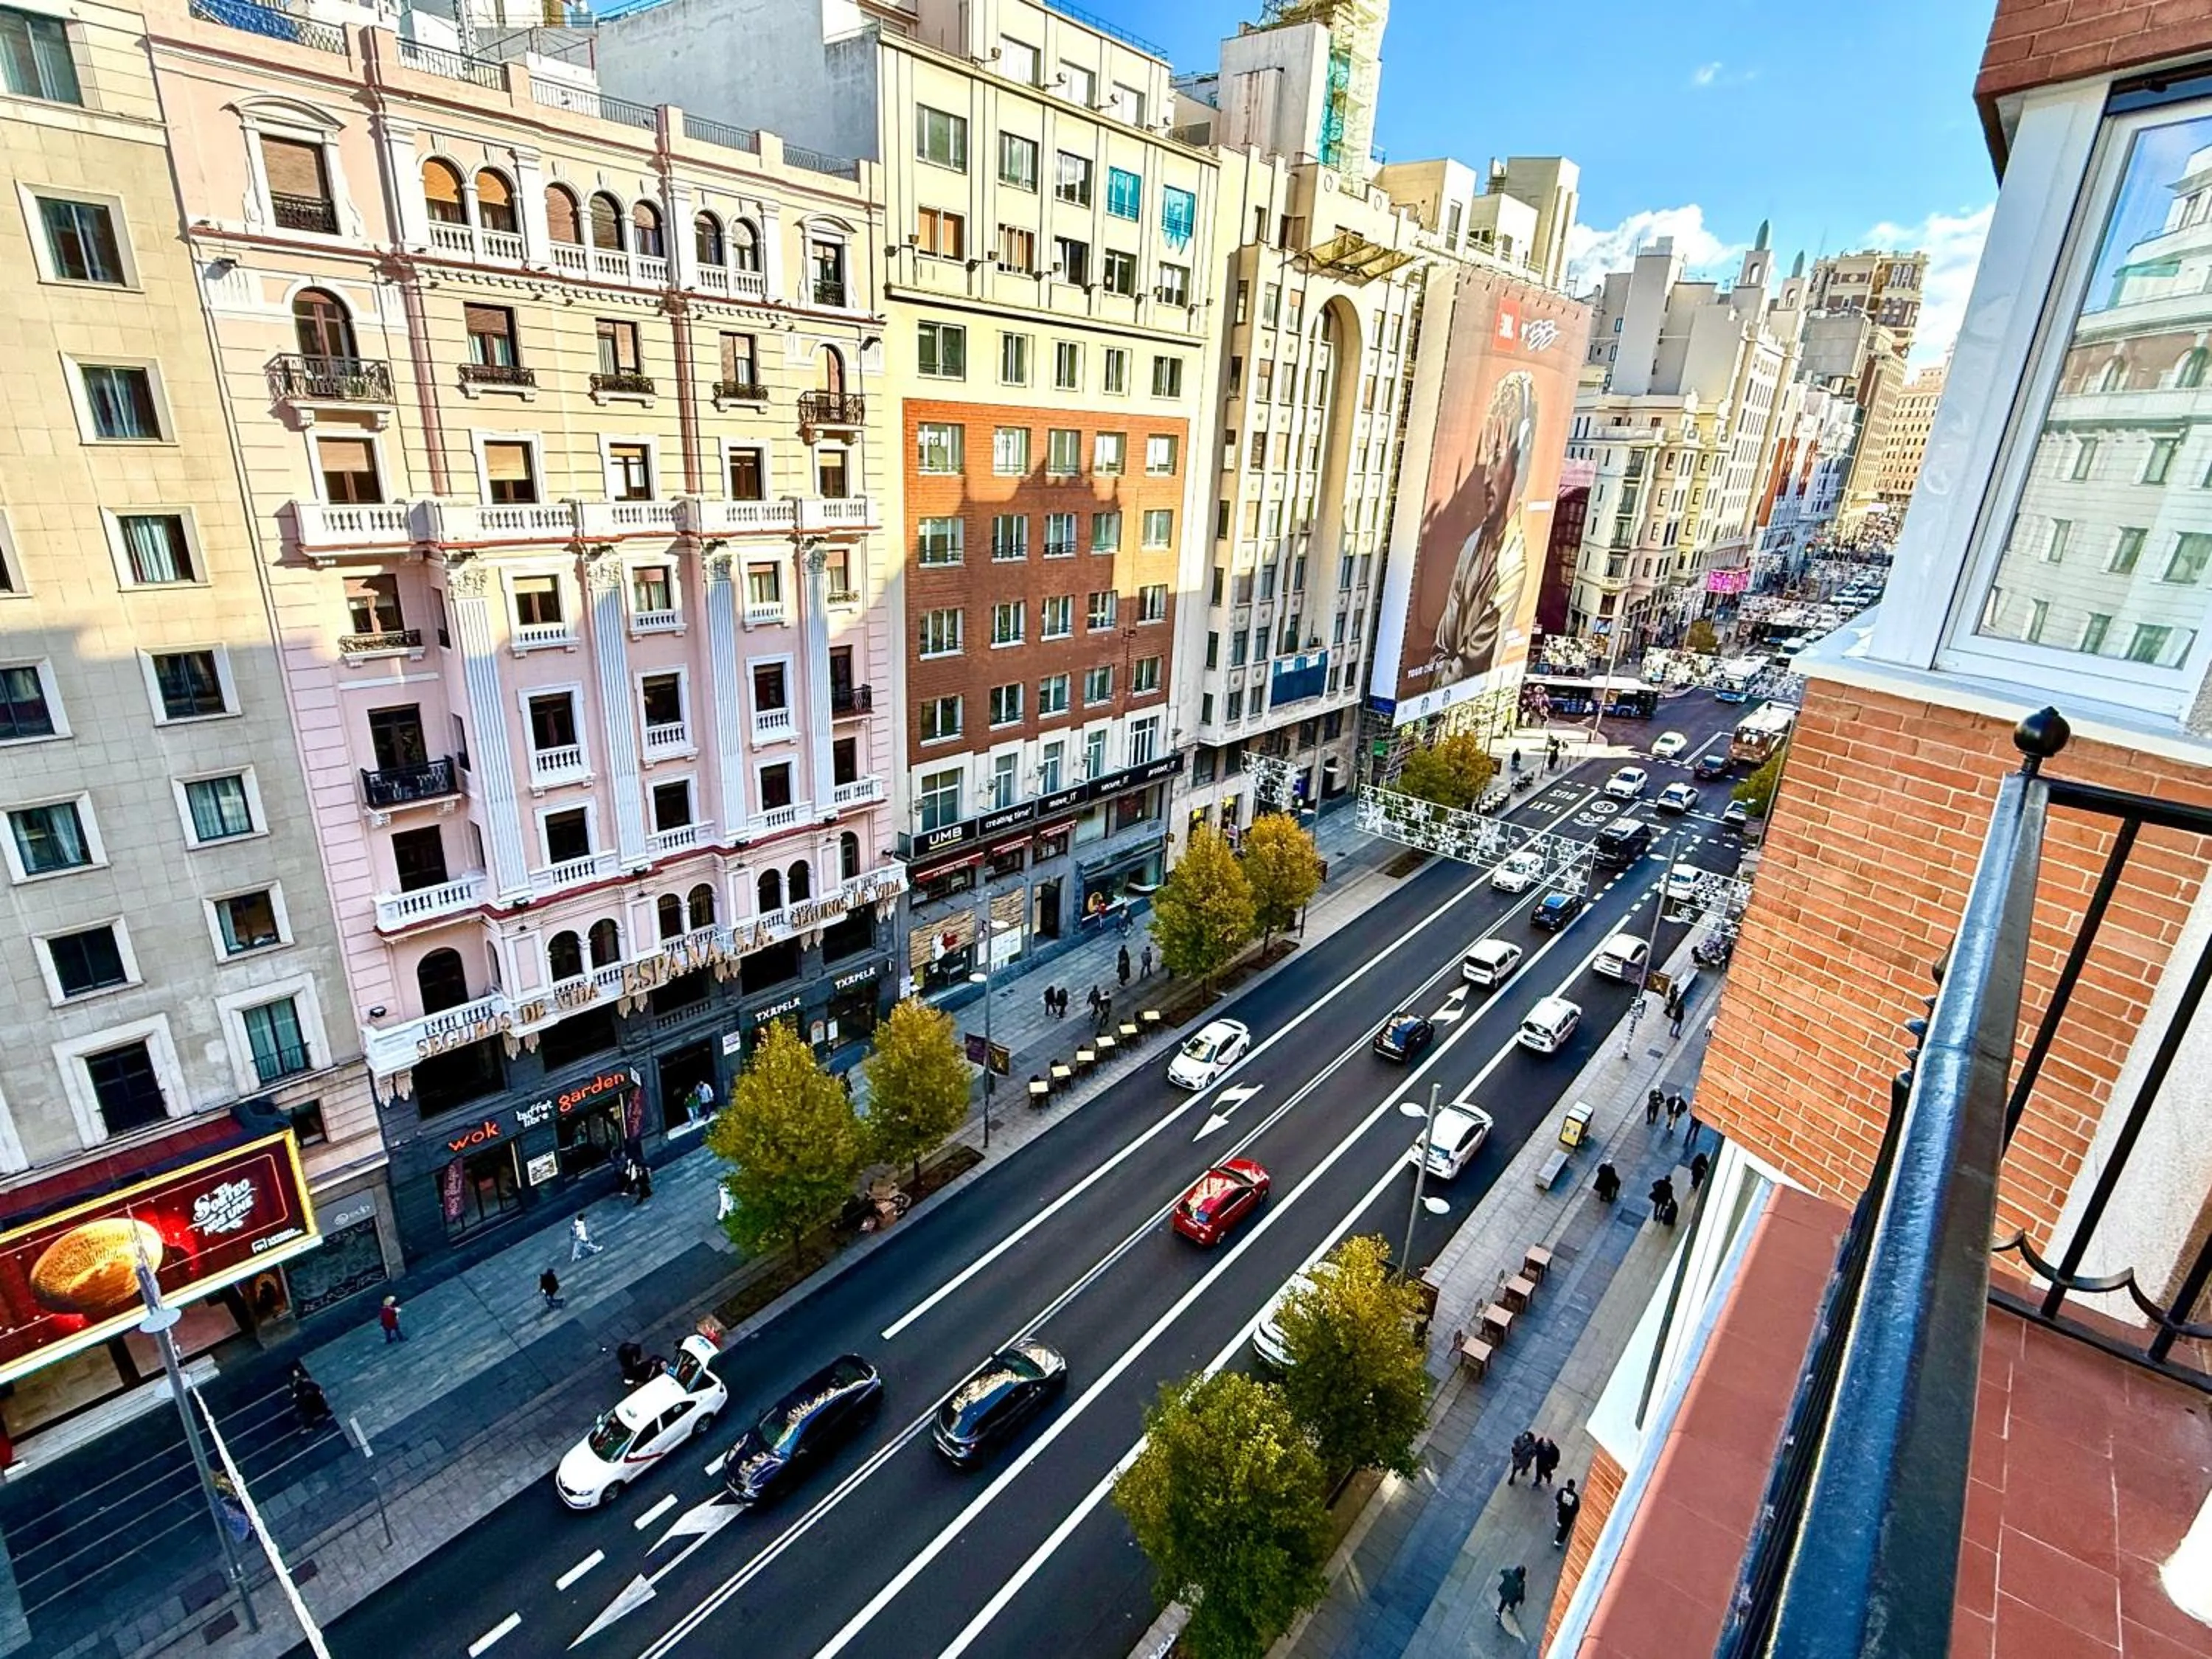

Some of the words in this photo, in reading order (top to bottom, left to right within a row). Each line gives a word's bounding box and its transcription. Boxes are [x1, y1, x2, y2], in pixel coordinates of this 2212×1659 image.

[1549, 789, 1579, 800] BUS
[1528, 801, 1562, 814] TAXI
[985, 814, 1015, 829] creating
[928, 827, 963, 845] UMB
[415, 1011, 512, 1059] SEGUROS
[521, 998, 546, 1024] DE
[557, 982, 600, 1010] VIDA
[792, 894, 849, 929] SEGUROS
[853, 888, 869, 907] DE
[876, 877, 902, 899] VIDA
[835, 967, 876, 990] TXAPELA
[755, 997, 801, 1023] TXAPELA
[558, 1072, 626, 1113] garden
[516, 1099, 553, 1121] buffet
[524, 1112, 550, 1127] libre
[448, 1121, 501, 1152] wok
[227, 1194, 254, 1216] UNE
